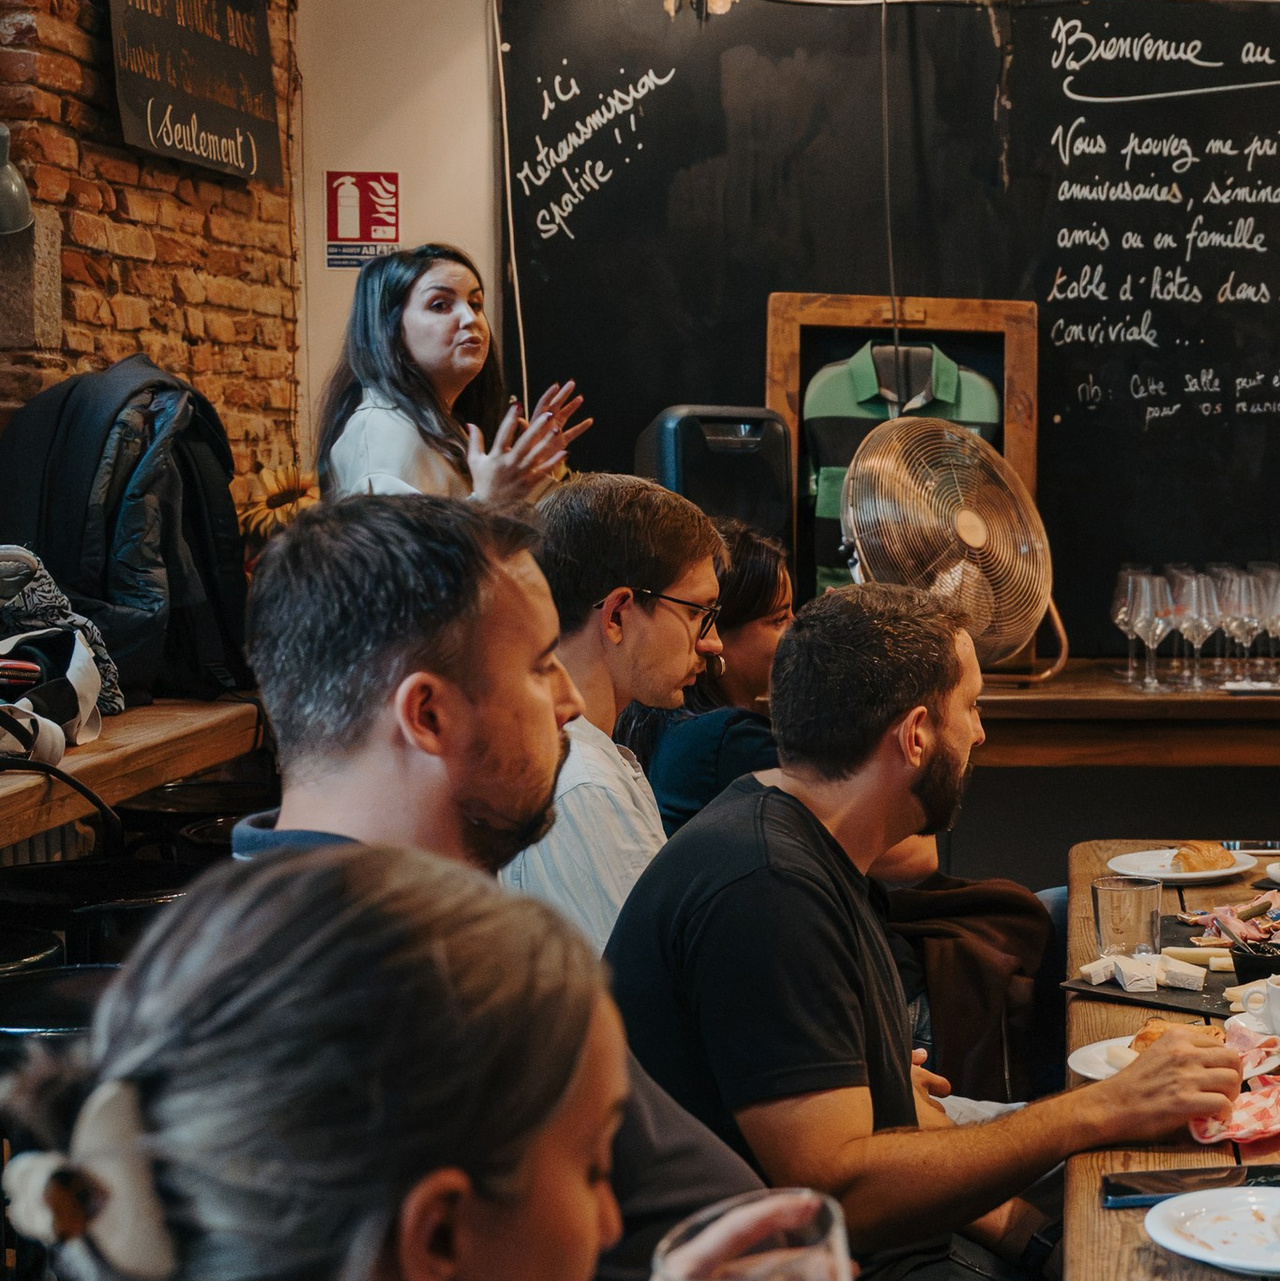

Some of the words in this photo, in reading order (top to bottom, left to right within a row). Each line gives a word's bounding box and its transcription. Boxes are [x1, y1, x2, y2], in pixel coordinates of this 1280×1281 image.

[1052, 18, 1222, 70] Bienvenue
[1242, 43, 1274, 63] au
[538, 59, 580, 120] ici
[1051, 117, 1106, 165] Vous
[1121, 133, 1199, 176] pouvez
[1206, 140, 1238, 155] me
[1058, 221, 1109, 250] amis
[1122, 232, 1143, 248] ou
[1154, 234, 1176, 248] en
[1186, 215, 1266, 261] famille
[1048, 265, 1107, 301] table
[1218, 272, 1270, 303] dans
